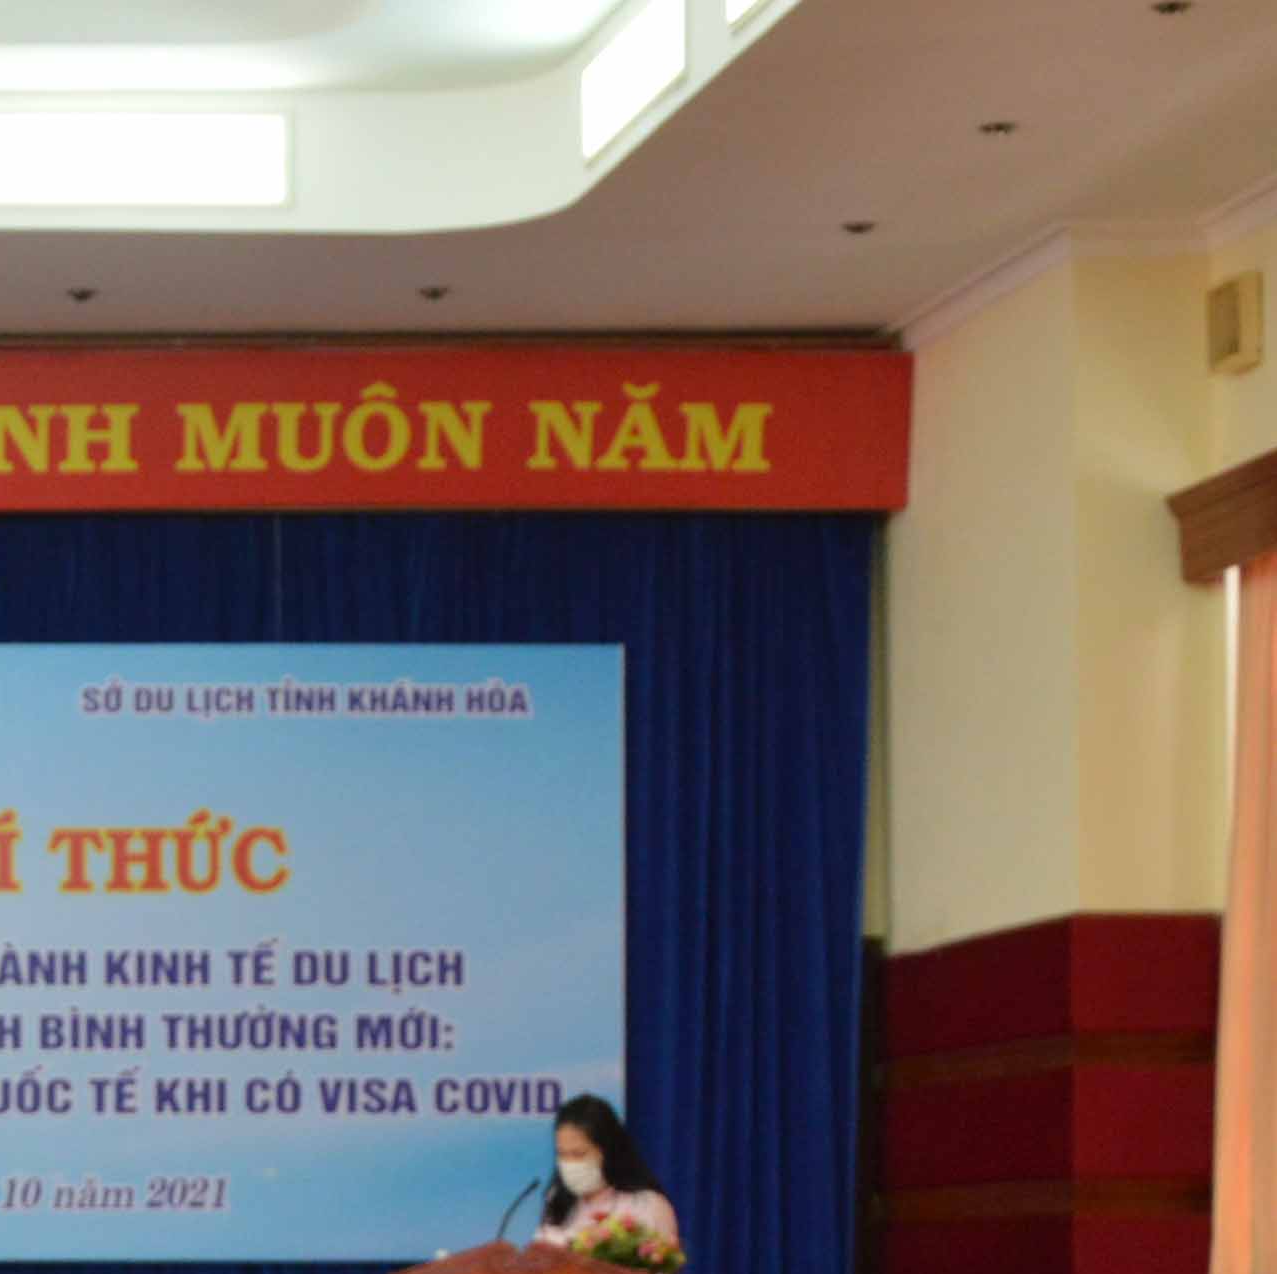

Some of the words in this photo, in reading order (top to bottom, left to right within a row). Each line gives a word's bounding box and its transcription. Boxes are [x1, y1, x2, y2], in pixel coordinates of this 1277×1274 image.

[176, 382, 493, 473] MUÔN
[527, 383, 774, 474] NĂM
[82, 678, 124, 714] SỞ
[134, 687, 175, 714] DU
[187, 687, 256, 718] LỊCH
[267, 678, 337, 714] TỈNH
[348, 681, 456, 714] KHÁNH
[465, 680, 530, 714] HÒA
[46, 808, 293, 897] THỨC
[104, 951, 212, 987] KINH
[227, 939, 277, 987] TẾ
[292, 950, 351, 987] DU
[367, 950, 465, 995] LỊCH
[39, 1009, 146, 1051] BÌNH
[162, 1008, 340, 1051] THƯỜNG
[356, 1008, 455, 1052] MỚI:
[89, 1069, 139, 1115] TẾ
[155, 1079, 228, 1115] KHI
[245, 1073, 303, 1116] CÓ
[319, 1079, 418, 1115] VISA
[435, 1078, 562, 1115] COVID
[3, 1178, 45, 1212] 10
[53, 1178, 136, 1211] năm
[145, 1178, 229, 1211] 2021
